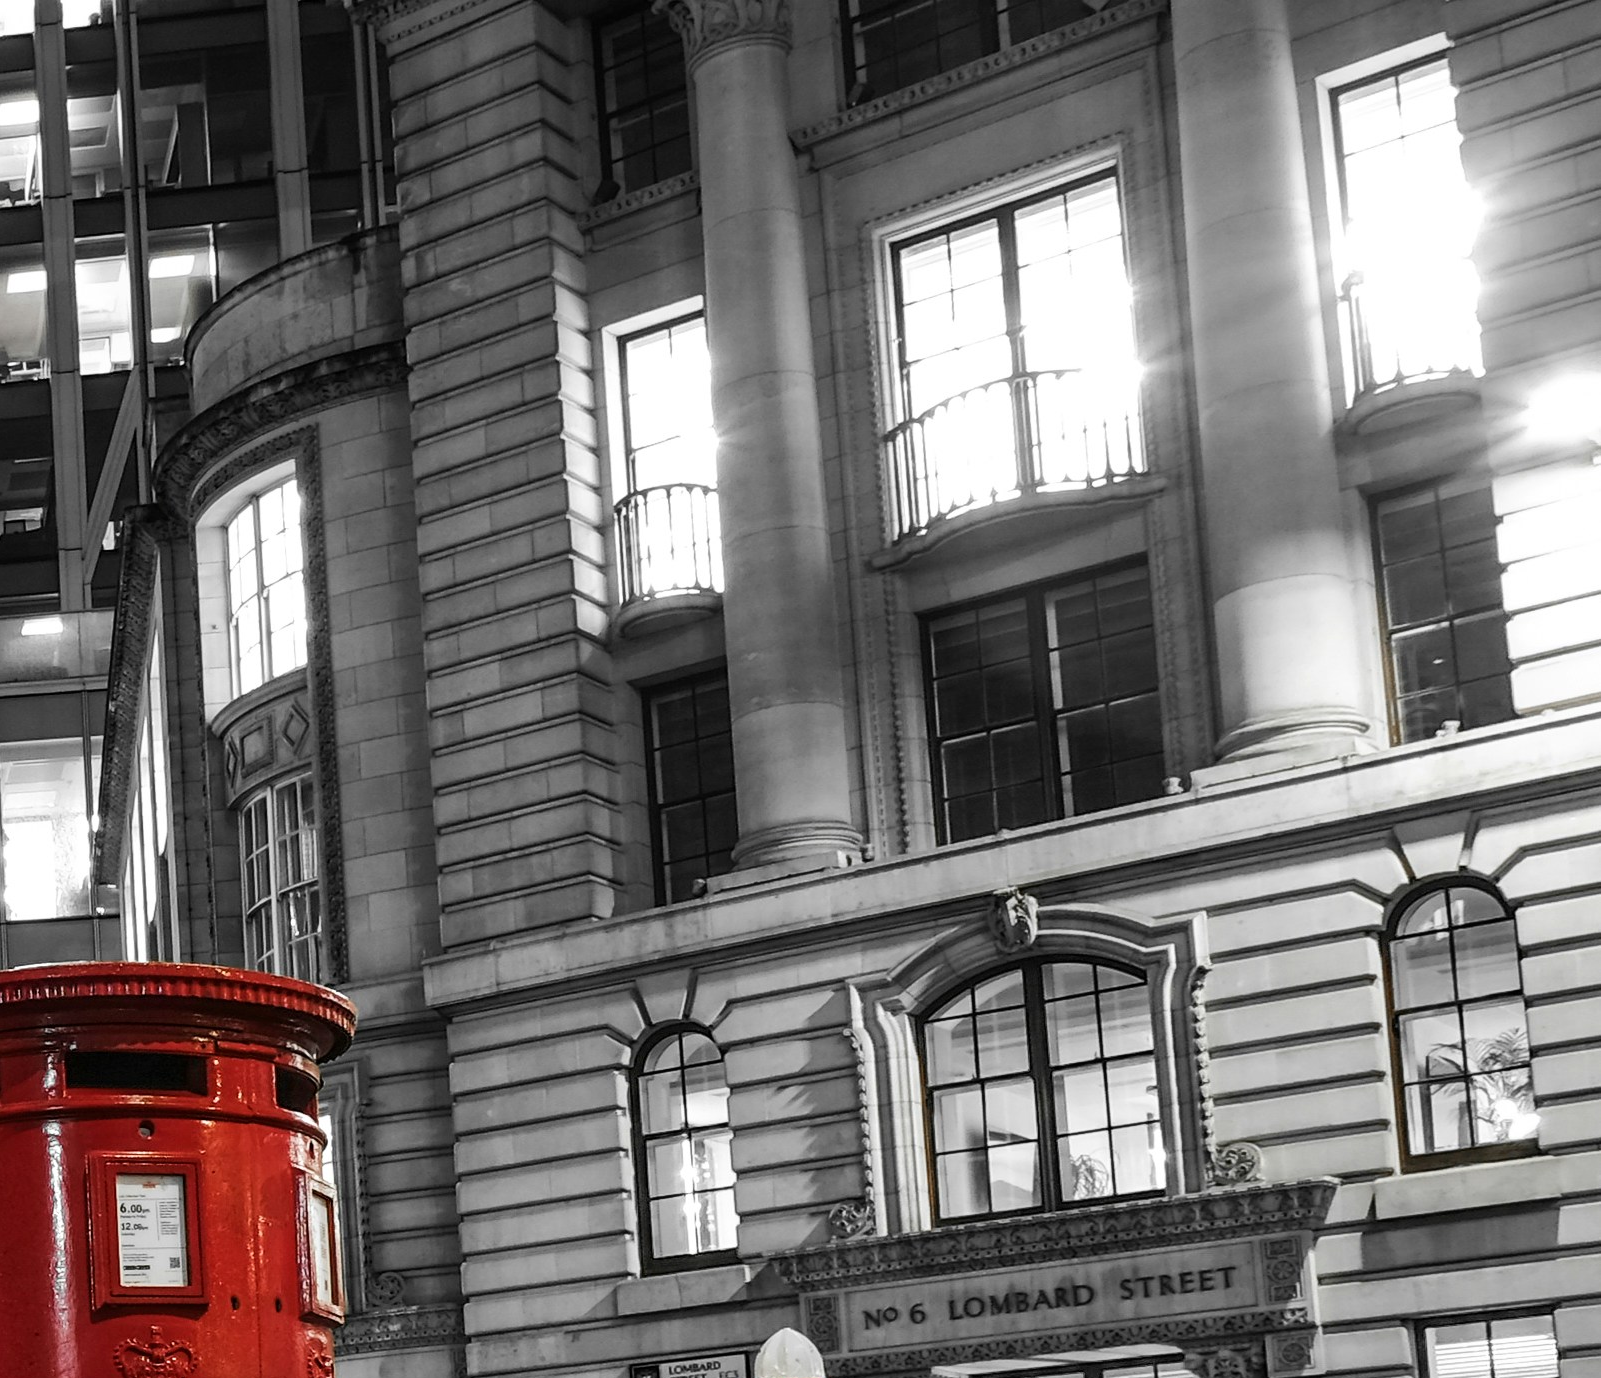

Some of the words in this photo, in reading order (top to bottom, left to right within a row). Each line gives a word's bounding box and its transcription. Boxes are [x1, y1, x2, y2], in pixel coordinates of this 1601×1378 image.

[909, 1301, 927, 1326] 6
[947, 1284, 1096, 1322] LOMBARD
[1119, 1266, 1238, 1301] STREET
[668, 1361, 722, 1376] LOMBARD
